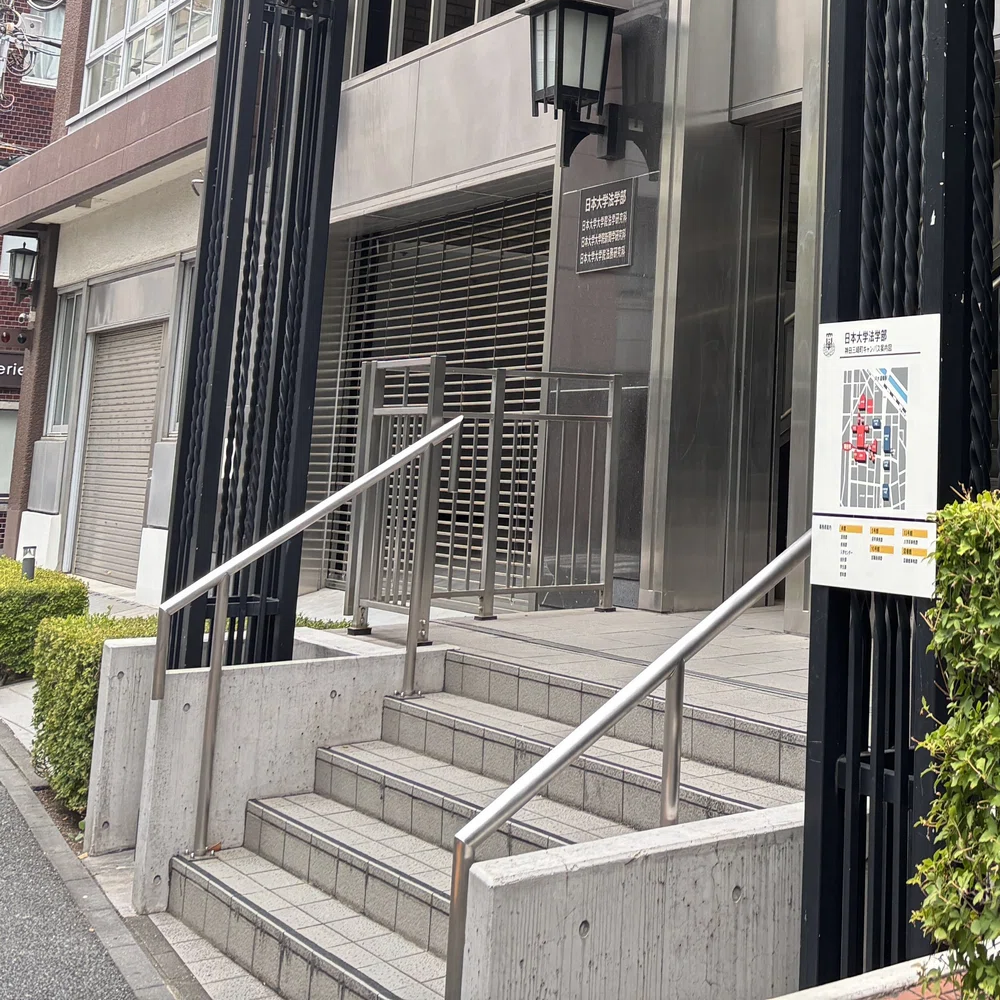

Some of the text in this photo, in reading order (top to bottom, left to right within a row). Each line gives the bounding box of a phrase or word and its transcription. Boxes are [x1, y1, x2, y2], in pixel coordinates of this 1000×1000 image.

[585, 189, 627, 212] 日本大学法学部
[844, 329, 887, 344] 日本大学法学部
